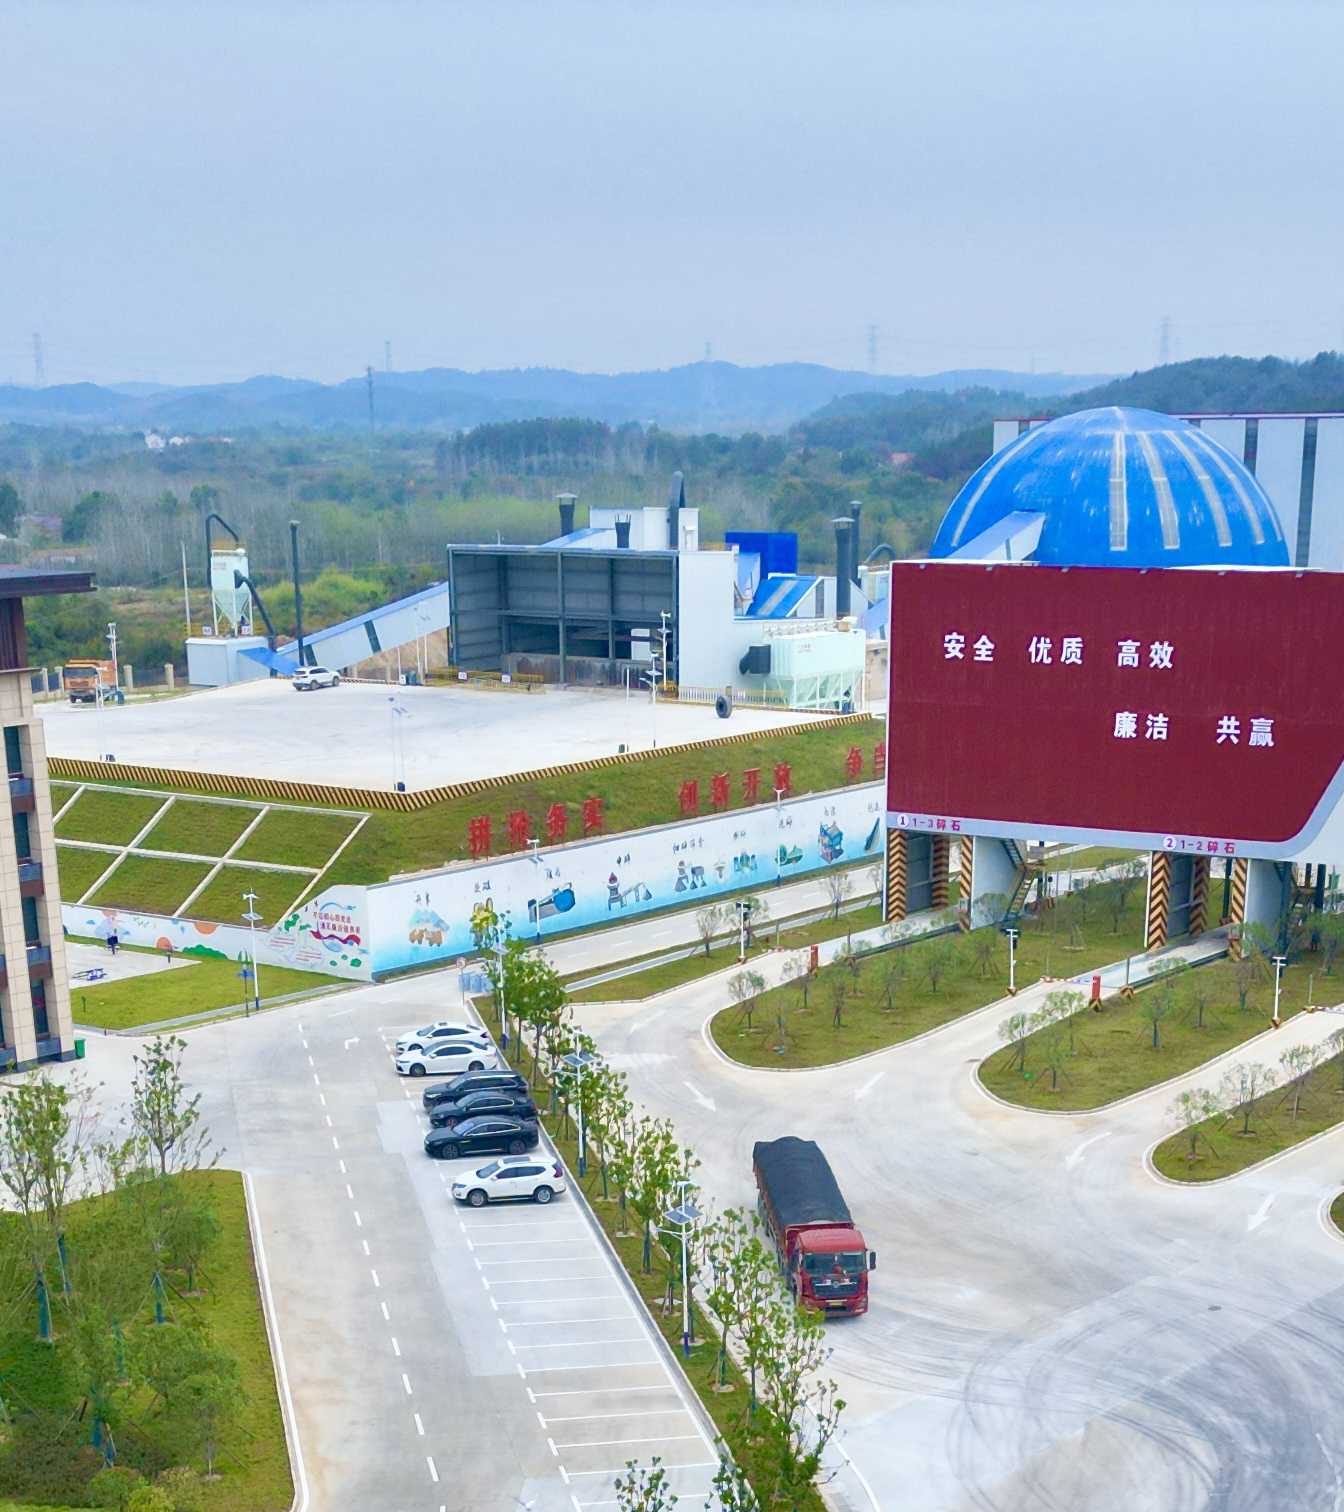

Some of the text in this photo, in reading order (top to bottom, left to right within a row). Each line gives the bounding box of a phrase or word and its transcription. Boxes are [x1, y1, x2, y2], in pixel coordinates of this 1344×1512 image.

[943, 631, 1175, 669] 安全 优质 高效
[1113, 711, 1274, 747] 廉洁 共赢
